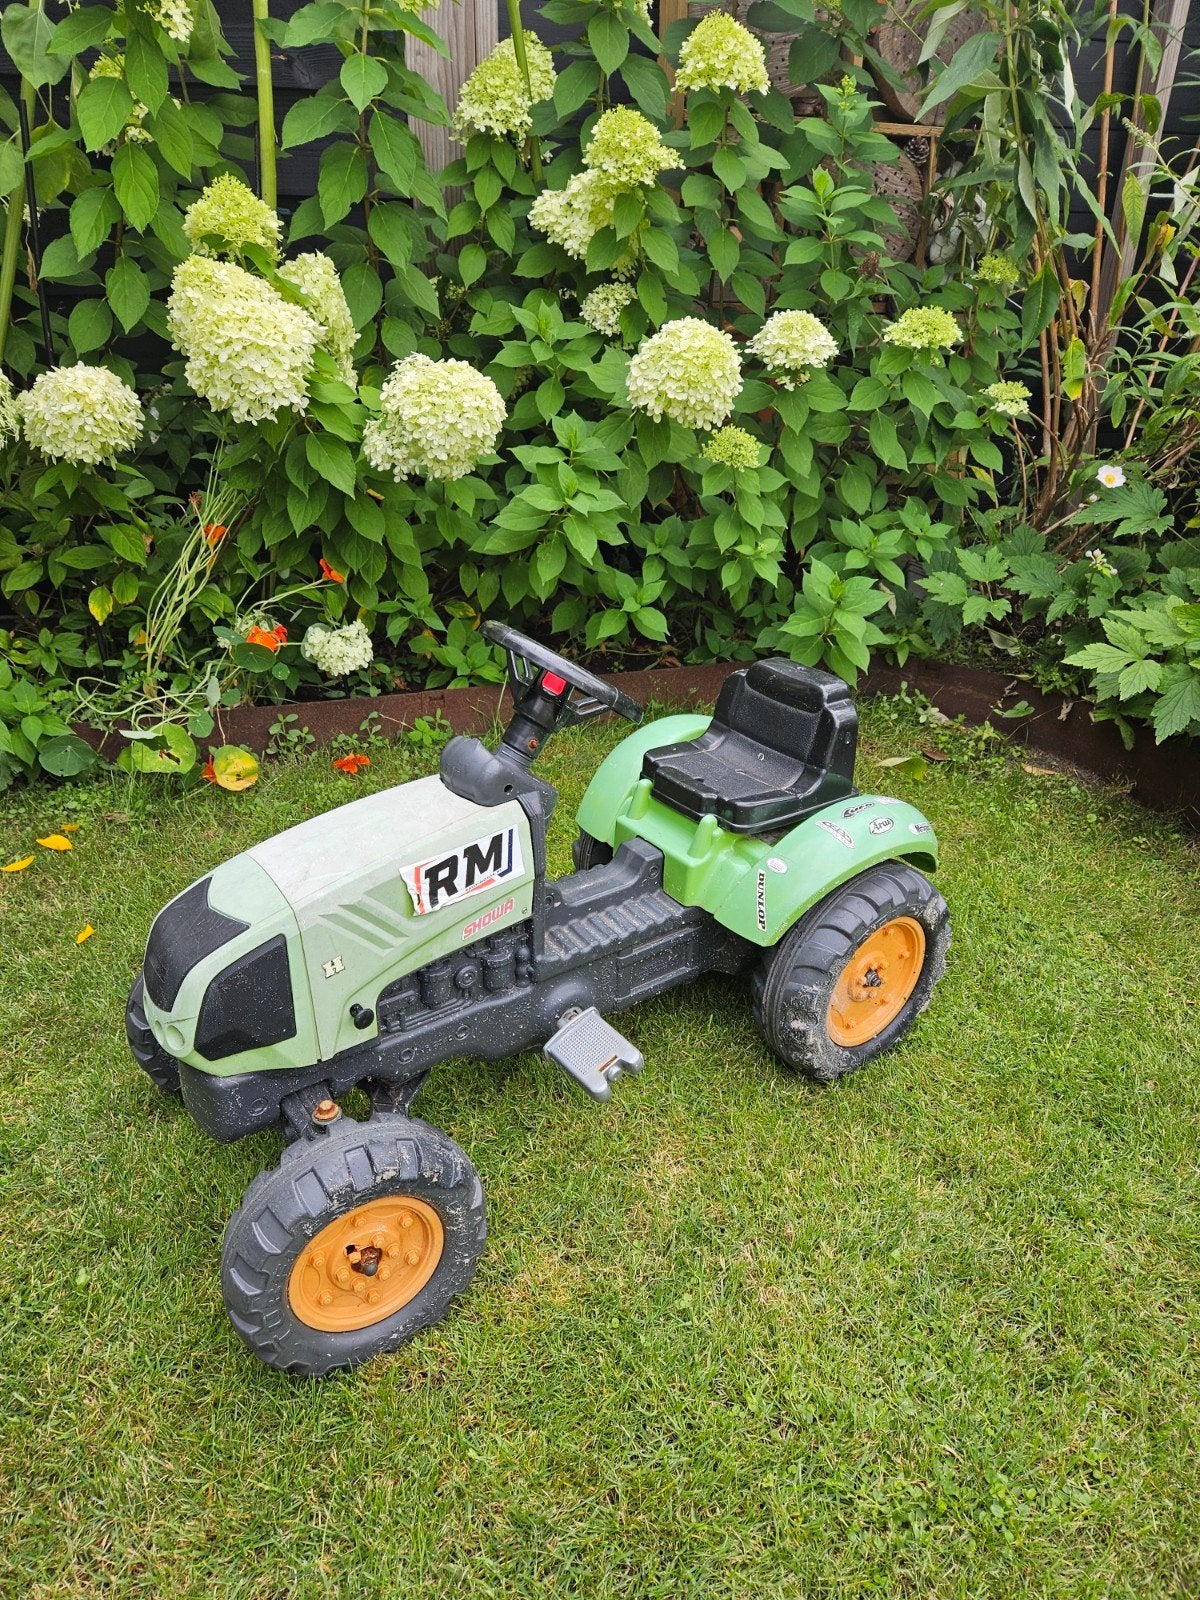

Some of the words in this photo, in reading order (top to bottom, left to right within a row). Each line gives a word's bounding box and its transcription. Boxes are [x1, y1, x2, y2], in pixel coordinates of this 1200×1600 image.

[425, 833, 503, 908] RM
[463, 898, 514, 939] SHOWA
[757, 872, 766, 930] DUNLOP
